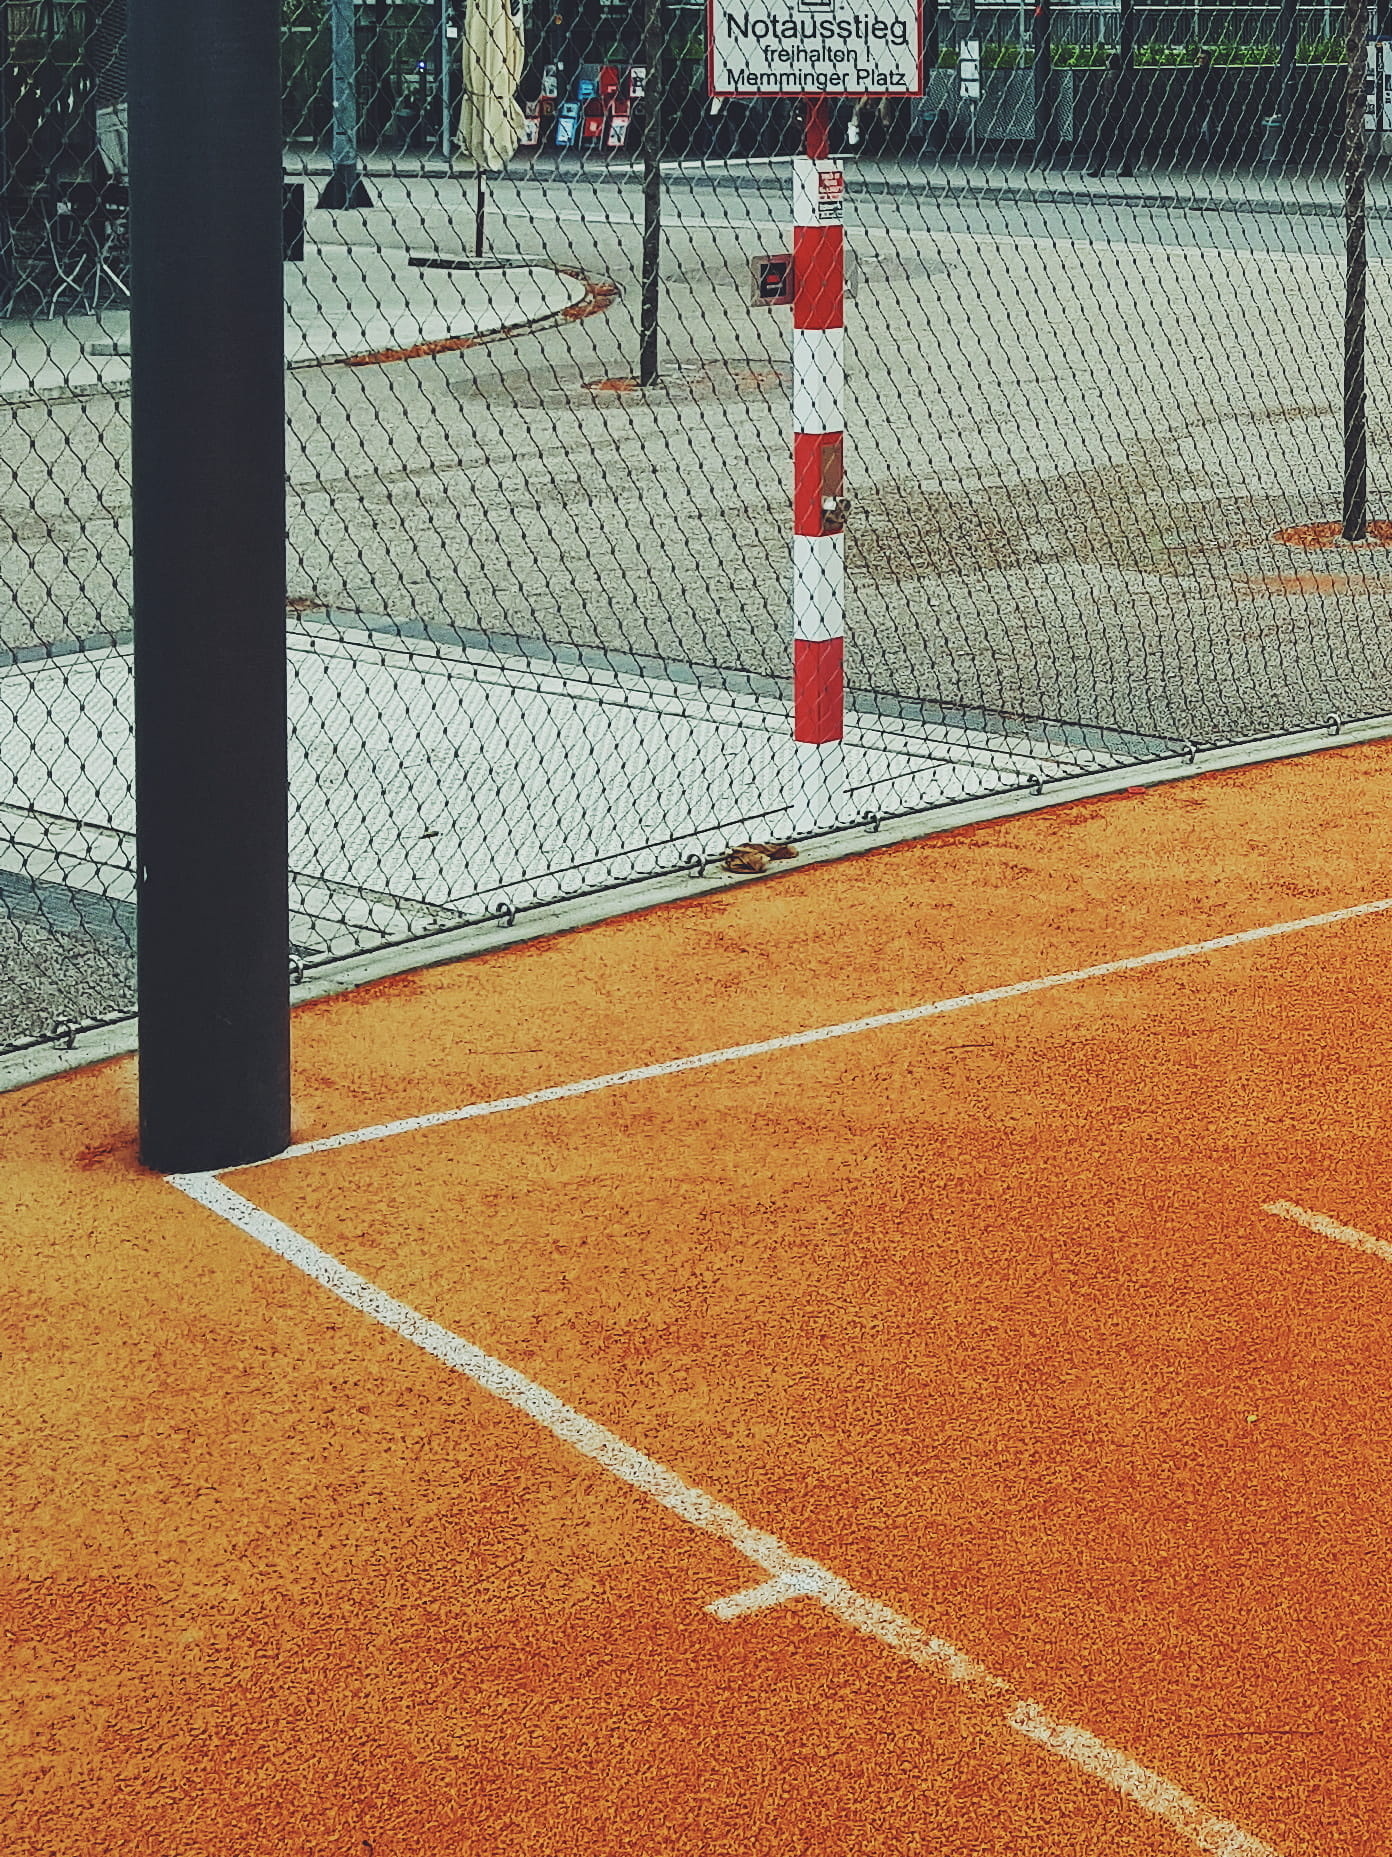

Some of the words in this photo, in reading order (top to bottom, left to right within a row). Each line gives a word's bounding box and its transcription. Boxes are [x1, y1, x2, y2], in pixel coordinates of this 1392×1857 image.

[727, 13, 908, 45] Notausstieg
[764, 45, 858, 63] freihalten
[727, 68, 849, 89] Memminger
[856, 68, 906, 86] Platz
